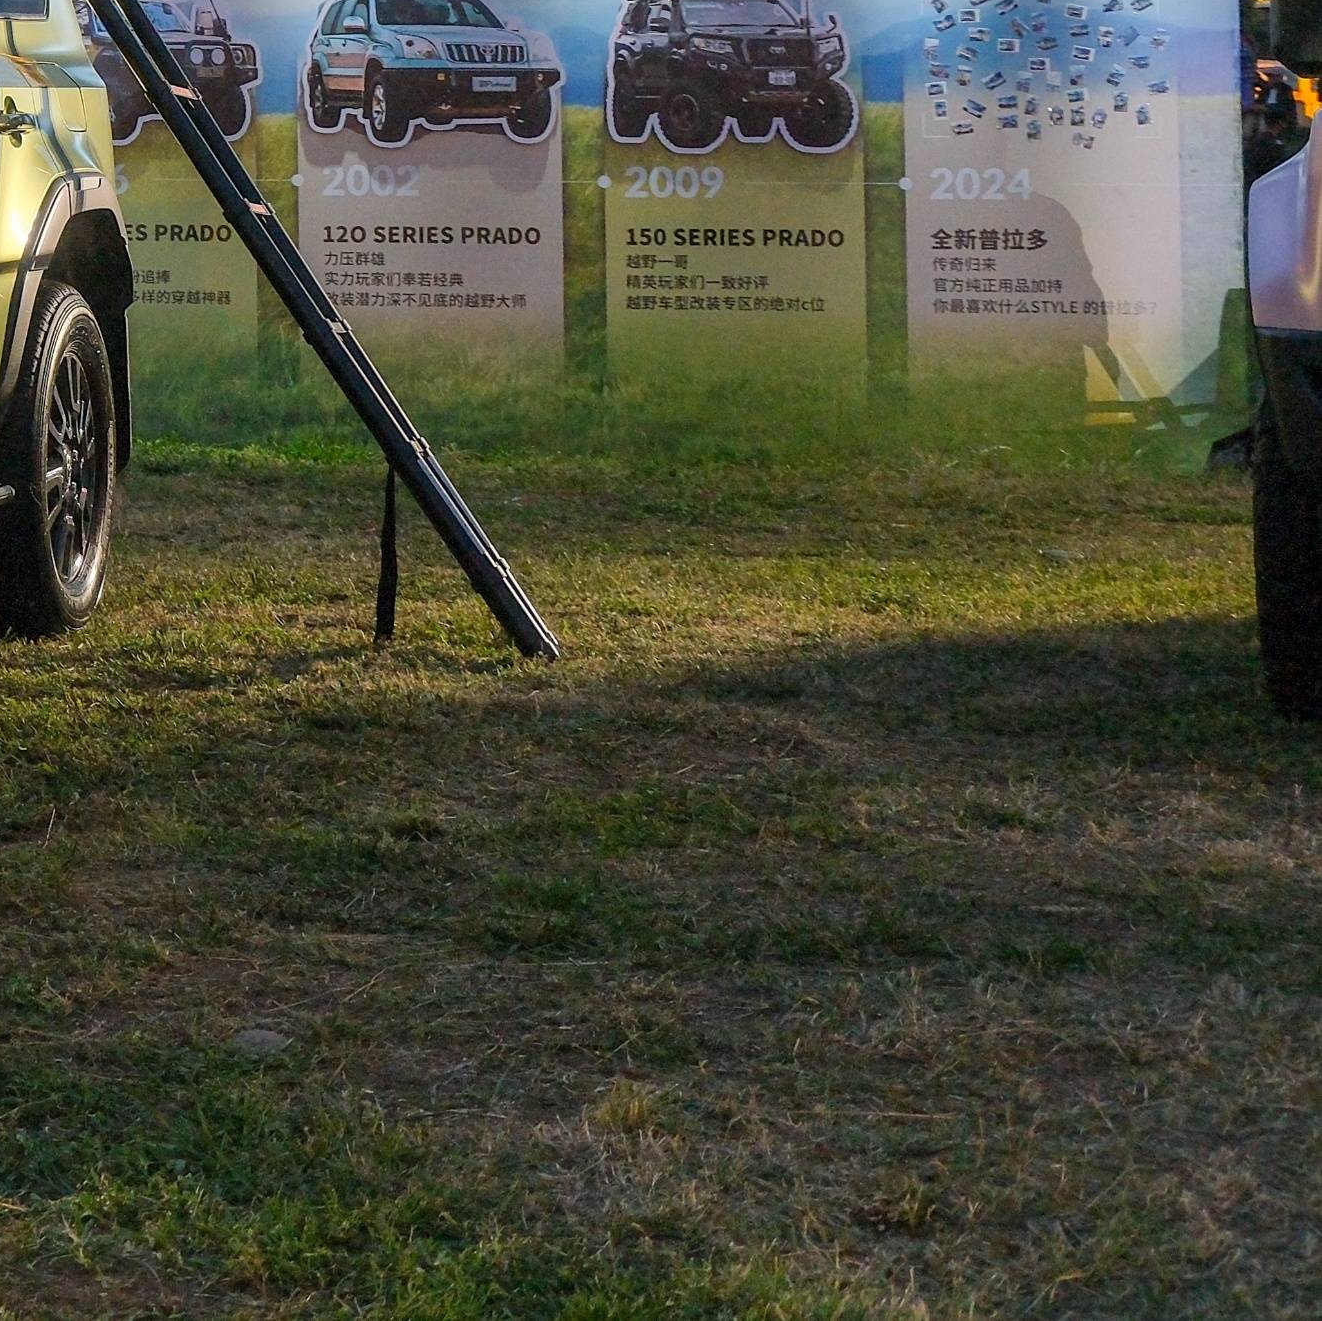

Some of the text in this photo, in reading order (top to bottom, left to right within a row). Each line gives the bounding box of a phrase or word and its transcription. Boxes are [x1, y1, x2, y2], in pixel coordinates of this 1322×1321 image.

[321, 164, 421, 197] 2002
[624, 165, 725, 199] 2009
[929, 166, 1033, 201] 2024
[153, 224, 232, 243] PRADO
[373, 225, 454, 245] SERIES
[460, 226, 542, 246] PRADO
[626, 228, 846, 248] 150 SERIES PRADO
[930, 228, 1049, 251] 全新普拉多
[323, 251, 386, 267] 力压群雄
[625, 254, 689, 270] 越野一哥
[932, 257, 998, 273] 传奇归来
